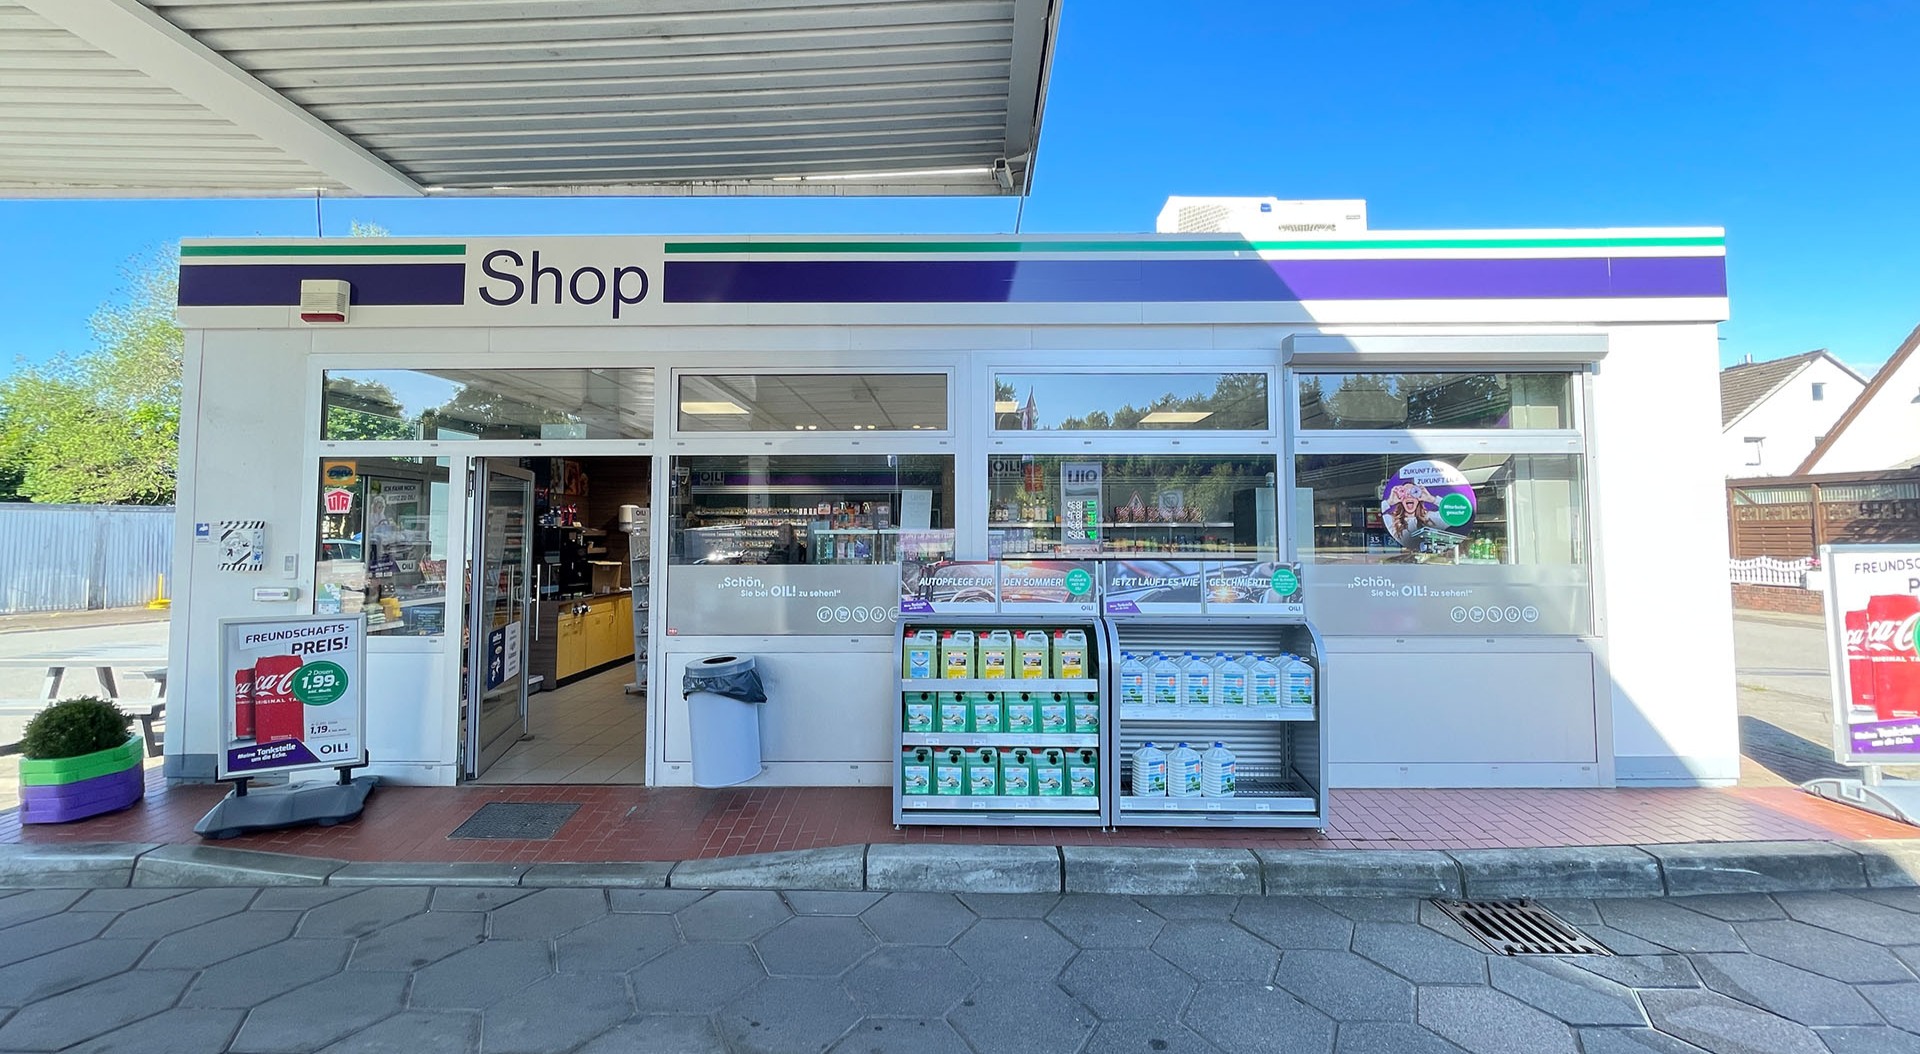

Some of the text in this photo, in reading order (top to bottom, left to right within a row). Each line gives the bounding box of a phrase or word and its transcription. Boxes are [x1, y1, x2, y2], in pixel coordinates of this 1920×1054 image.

[478, 249, 649, 319] Shop
[1403, 467, 1430, 475] ZUKUNFT
[1417, 477, 1446, 485] ZUKUNFT
[328, 491, 350, 511] UTA
[918, 577, 974, 587] AUTOPFLEGE
[1004, 577, 1021, 587] DEN
[1023, 577, 1064, 587] SOMMER!
[1111, 577, 1137, 587] JETZT
[1168, 577, 1181, 587] ES
[1182, 577, 1199, 587] WIE
[740, 589, 753, 597] Sie
[755, 588, 769, 597] bei
[770, 585, 796, 597] OIL!
[1370, 588, 1383, 597] Sie
[1386, 588, 1399, 597] bei
[1401, 585, 1427, 597] OIL!
[245, 623, 350, 644] FREUNDSCHAFTS-
[291, 636, 349, 655] PREIS!
[256, 743, 296, 756] Tankstelle
[320, 742, 349, 754] OIL!
